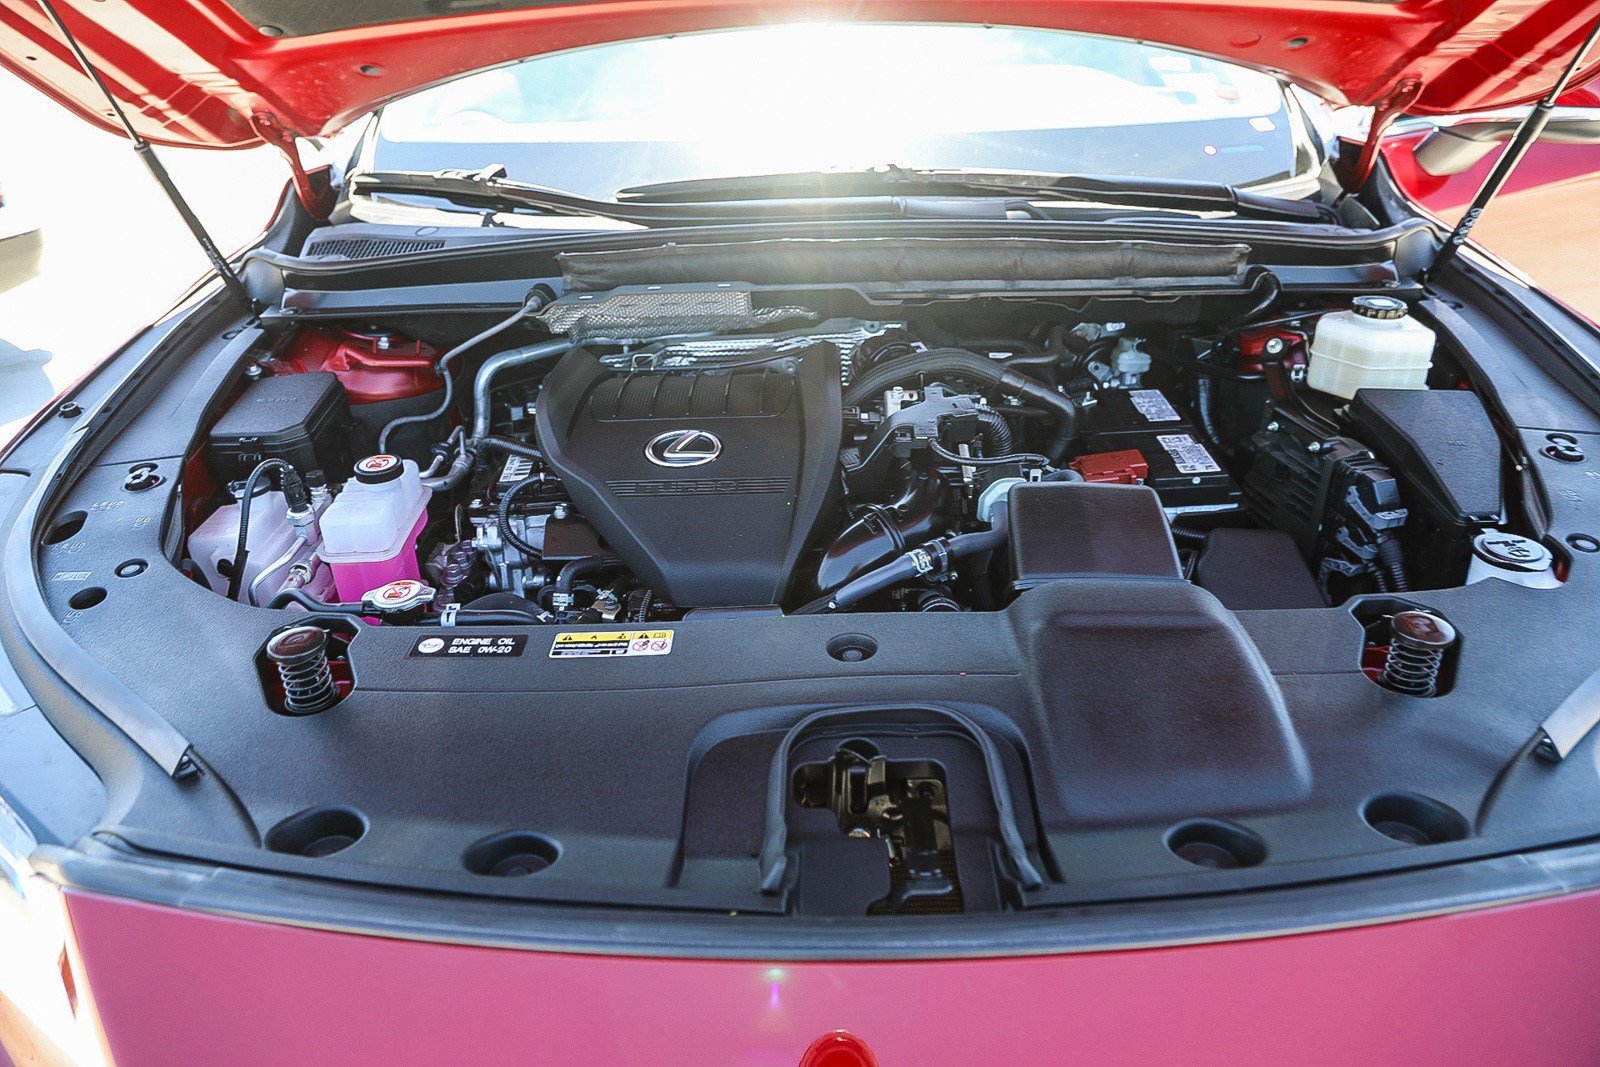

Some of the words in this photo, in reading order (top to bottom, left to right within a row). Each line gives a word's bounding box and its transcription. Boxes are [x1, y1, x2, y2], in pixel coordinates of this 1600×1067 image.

[451, 637, 493, 646] ENGINE
[497, 637, 516, 646] OIL
[447, 646, 473, 654] SAE
[477, 646, 513, 654] 0W-20
